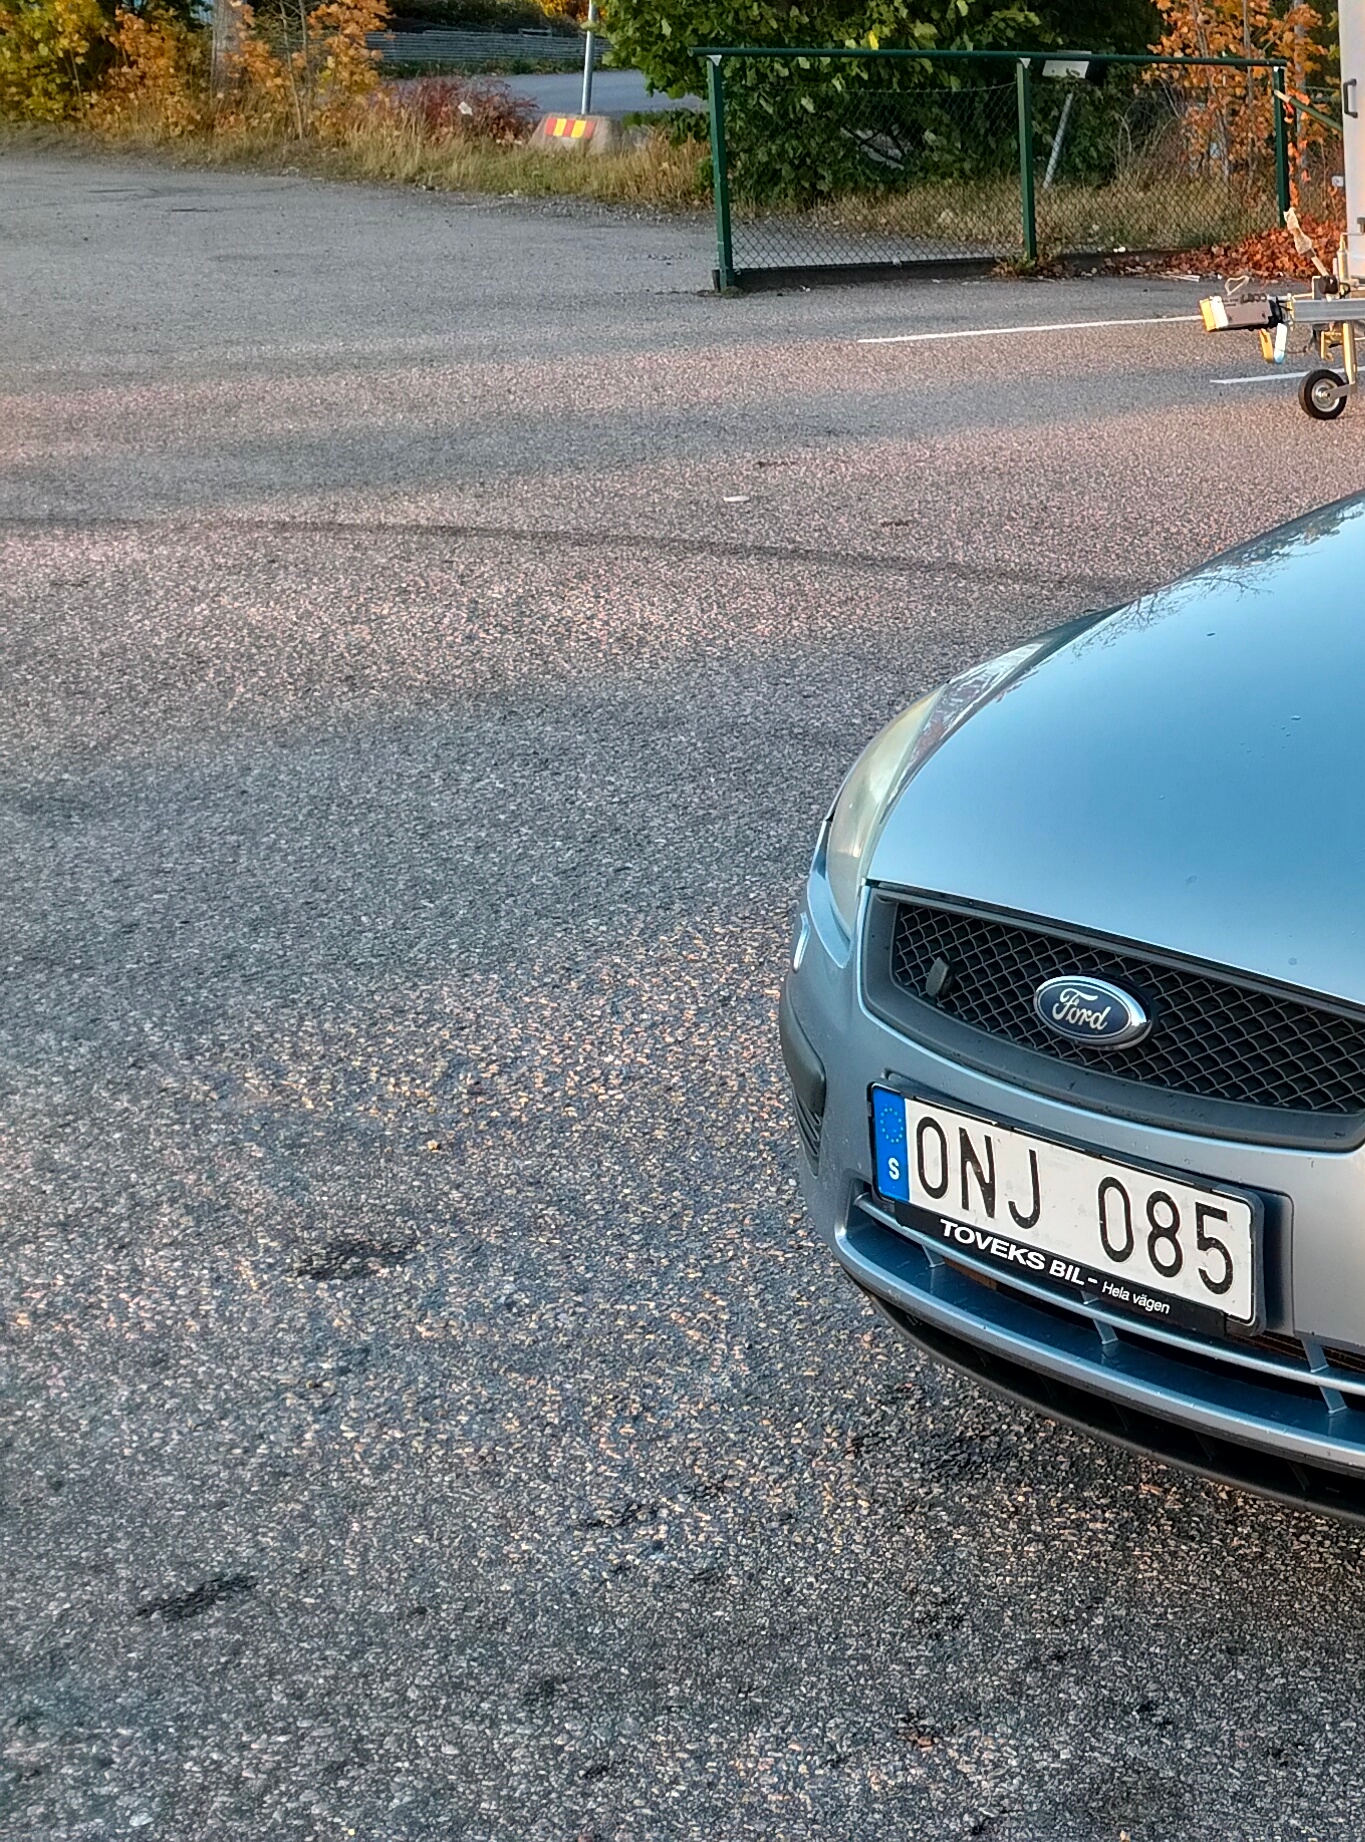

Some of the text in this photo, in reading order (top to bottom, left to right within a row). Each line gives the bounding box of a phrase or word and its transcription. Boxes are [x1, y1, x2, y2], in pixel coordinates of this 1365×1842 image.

[1052, 987, 1111, 1031] Ford
[887, 1157, 900, 1181] S
[916, 1116, 1235, 1296] ONJ 085
[939, 1218, 1046, 1271] TOVEKS
[1102, 1281, 1130, 1301] Hela
[1133, 1292, 1171, 1315] vägen
